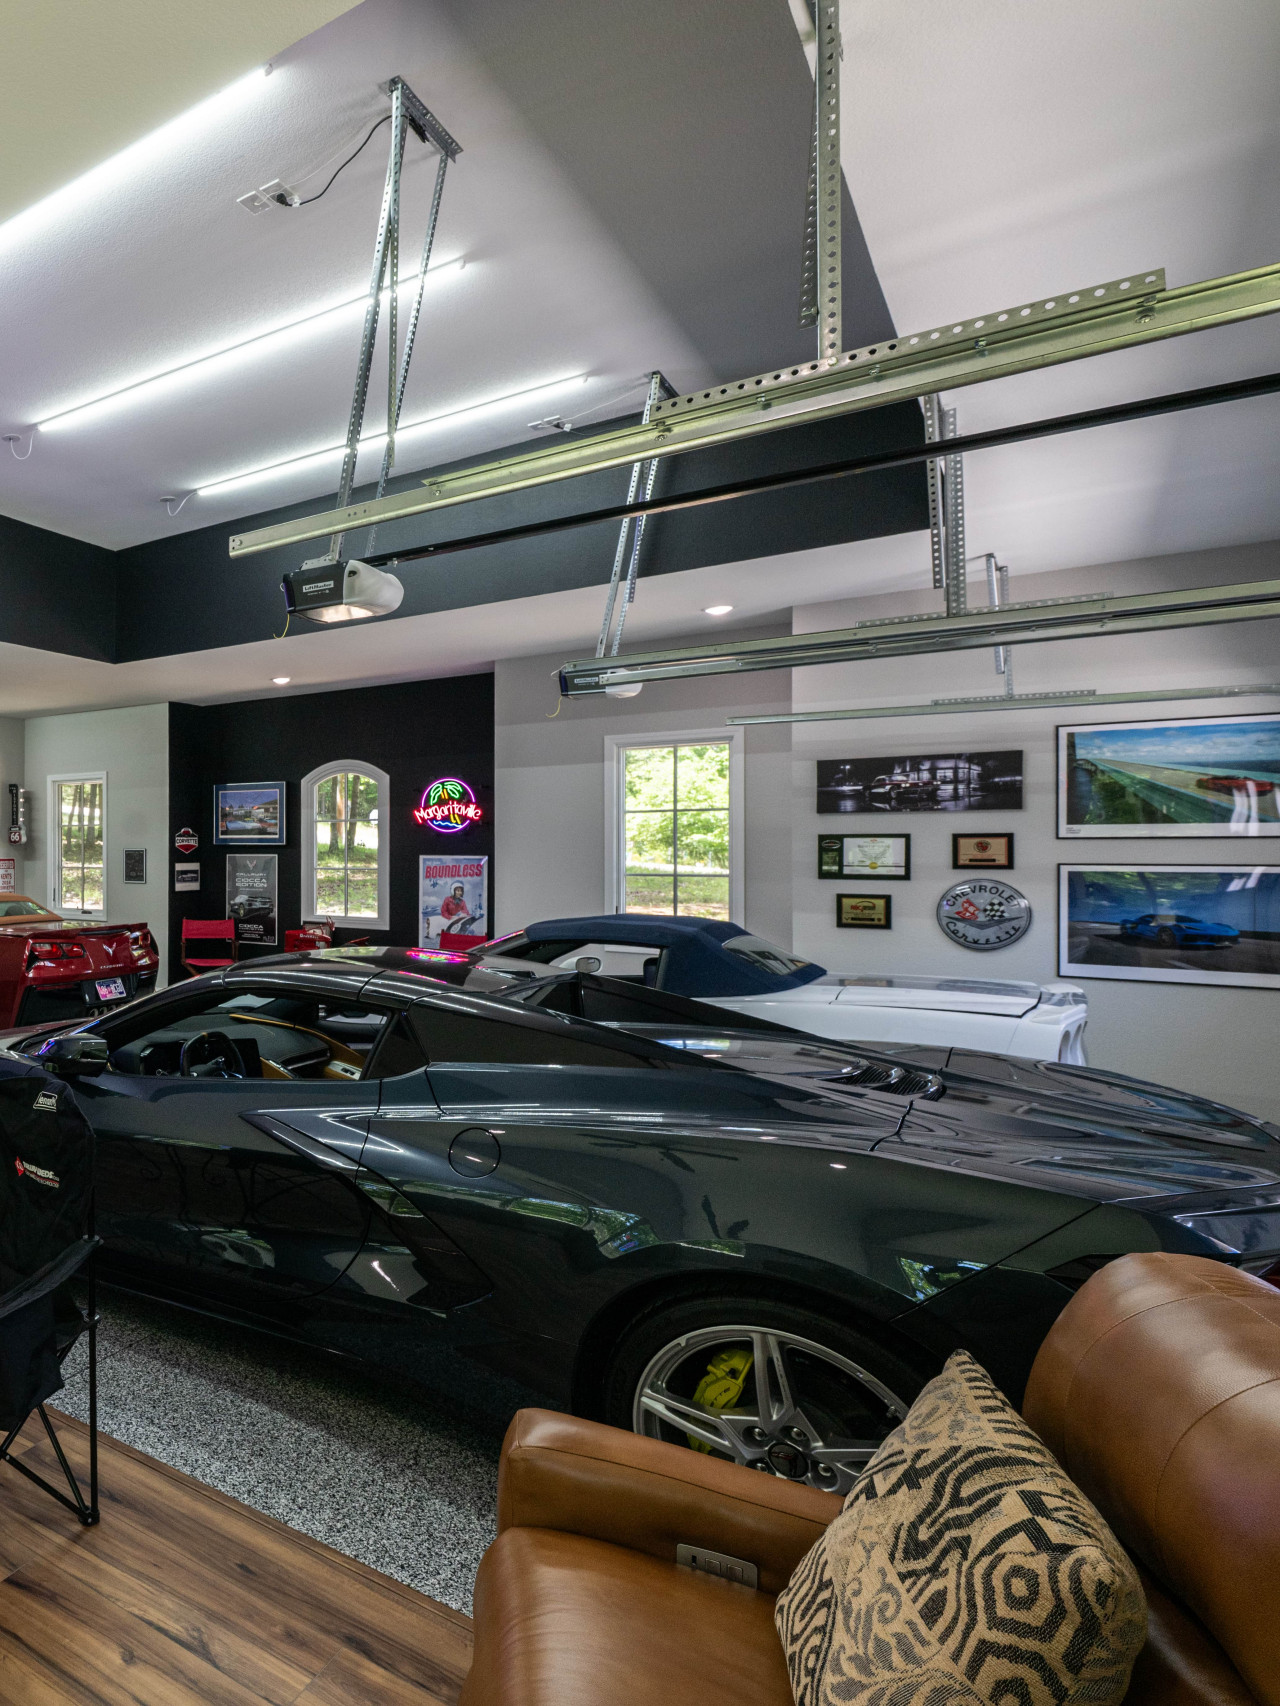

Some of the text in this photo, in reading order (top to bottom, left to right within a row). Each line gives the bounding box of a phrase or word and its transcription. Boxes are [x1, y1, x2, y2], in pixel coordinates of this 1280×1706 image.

[413, 800, 482, 825] Margaritaville
[10, 832, 20, 842] 66
[946, 884, 1022, 908] CHEVROLET
